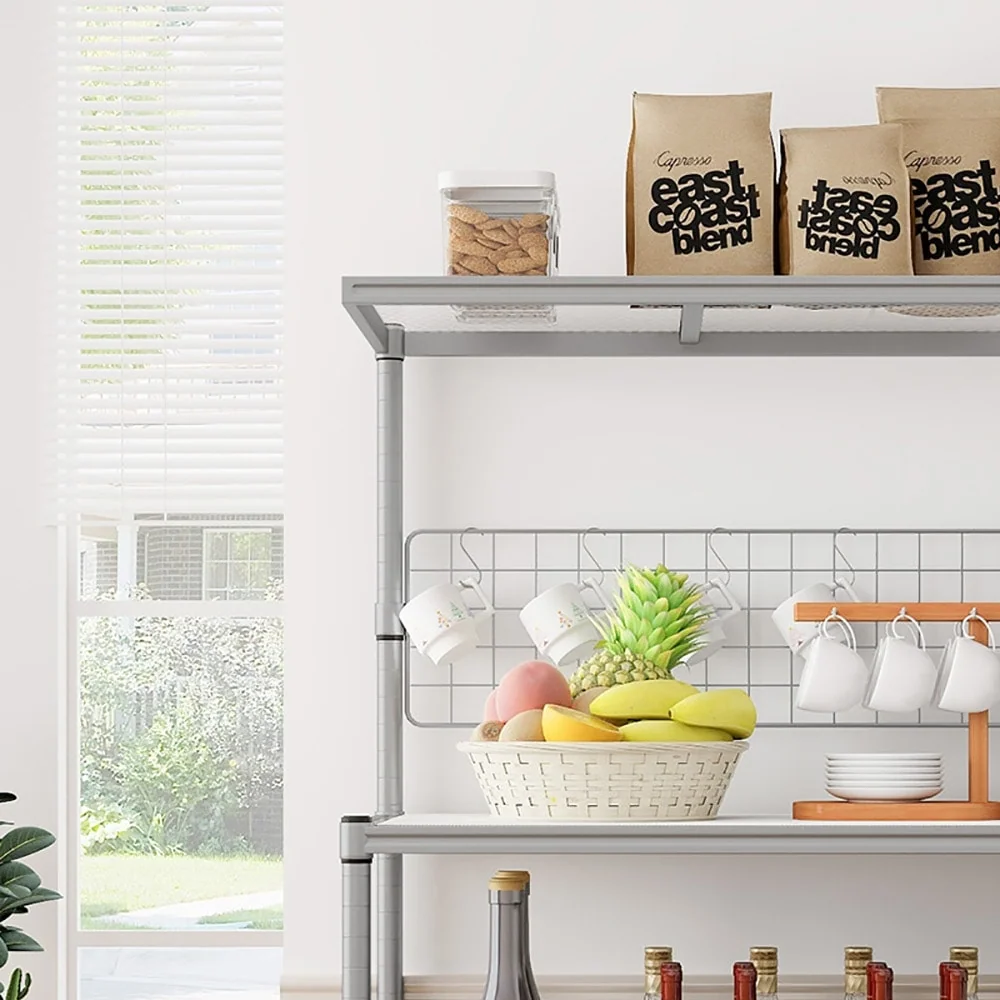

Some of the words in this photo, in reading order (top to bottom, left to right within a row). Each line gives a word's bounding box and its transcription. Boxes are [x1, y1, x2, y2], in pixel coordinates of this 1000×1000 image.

[653, 150, 712, 172] Capresso
[904, 150, 962, 172] Capresso
[651, 160, 745, 206] east
[649, 183, 760, 233] coast
[672, 216, 752, 255] blend
